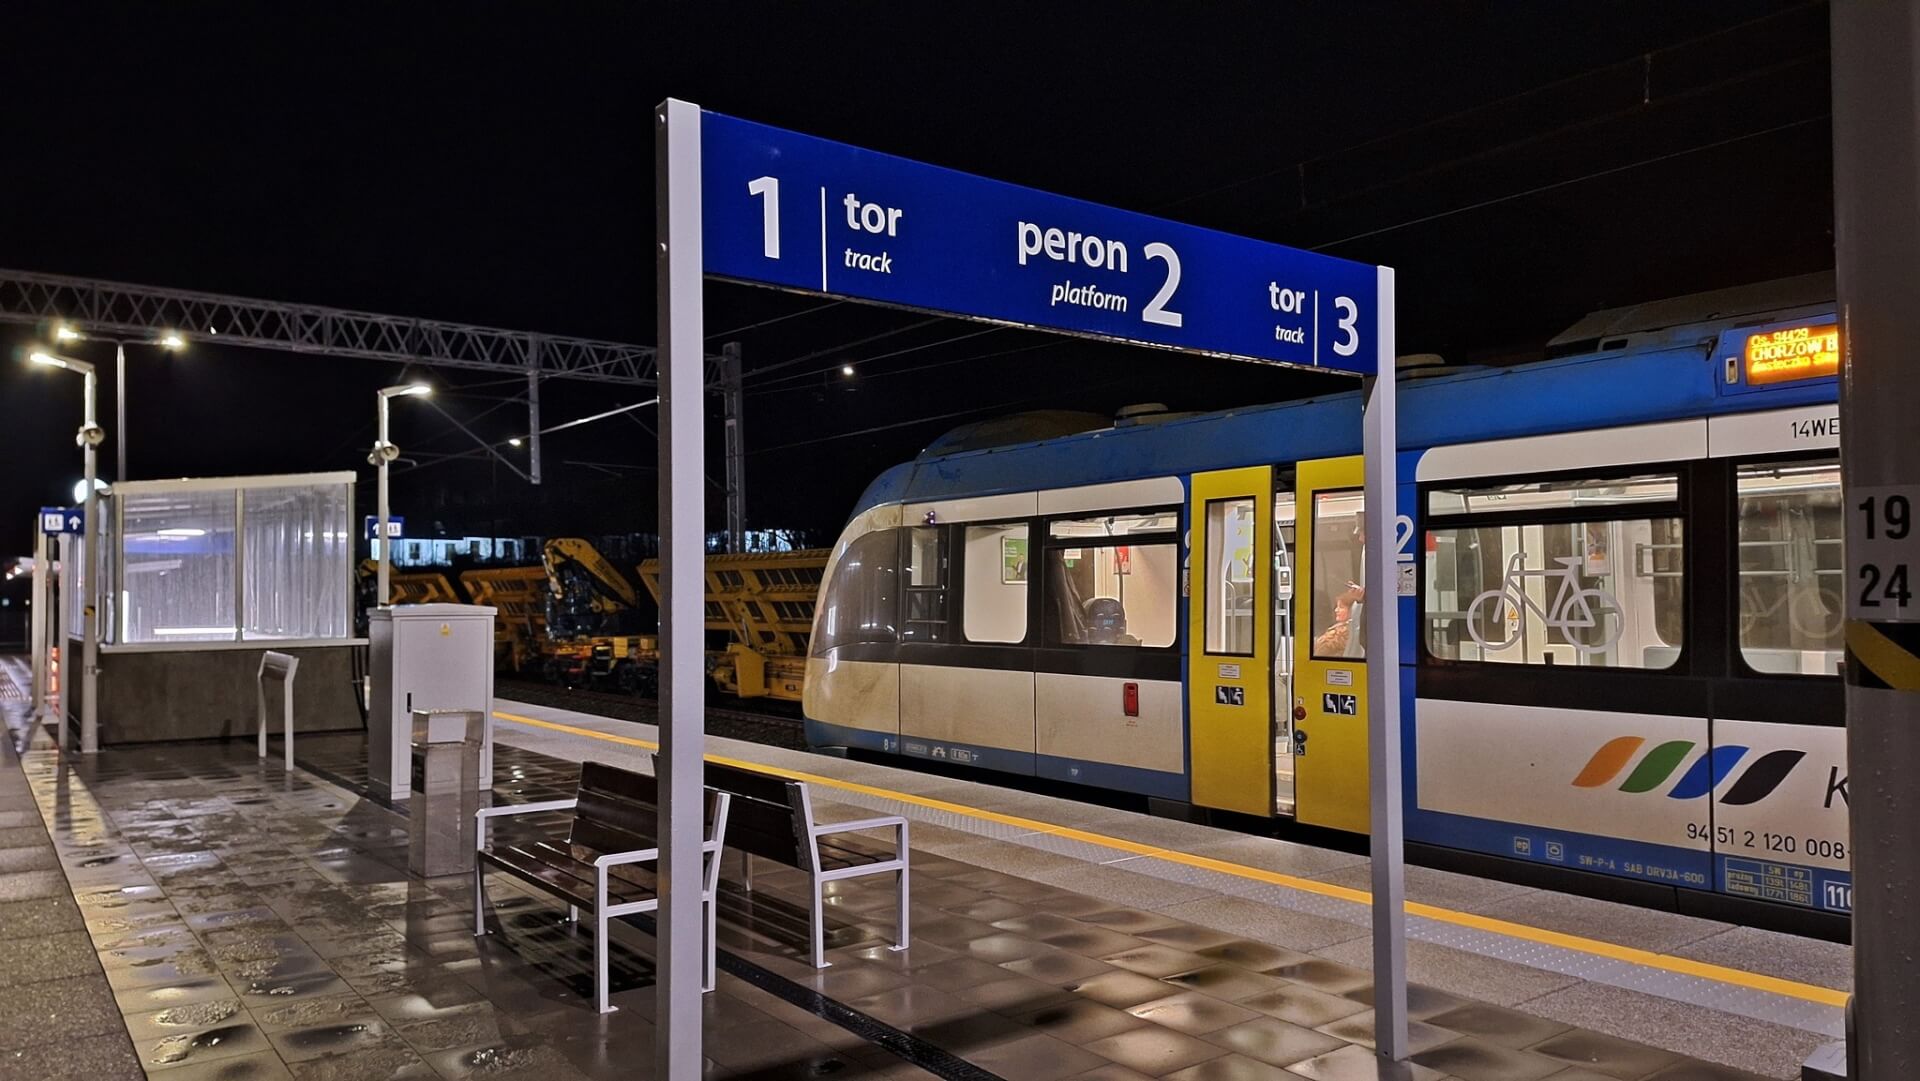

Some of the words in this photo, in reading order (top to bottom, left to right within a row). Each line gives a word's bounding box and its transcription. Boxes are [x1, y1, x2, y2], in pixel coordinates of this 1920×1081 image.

[749, 176, 780, 260] 1
[844, 193, 903, 237] tor
[844, 247, 892, 274] track
[1018, 221, 1128, 273] peron
[1051, 279, 1128, 313] platform
[1142, 242, 1183, 327] 2
[1269, 281, 1306, 314] tor
[1275, 325, 1305, 344] track
[1333, 296, 1360, 357] 3
[1791, 417, 1840, 439] 14WE
[1395, 514, 1414, 561] 2
[1858, 494, 1911, 540] 19
[1858, 563, 1913, 608] 24
[1824, 766, 1850, 809] K
[1686, 823, 1709, 842] 94
[1717, 826, 1735, 845] 51
[1743, 830, 1755, 848] 2
[1763, 832, 1796, 853] 120
[1624, 862, 1643, 875] SAB
